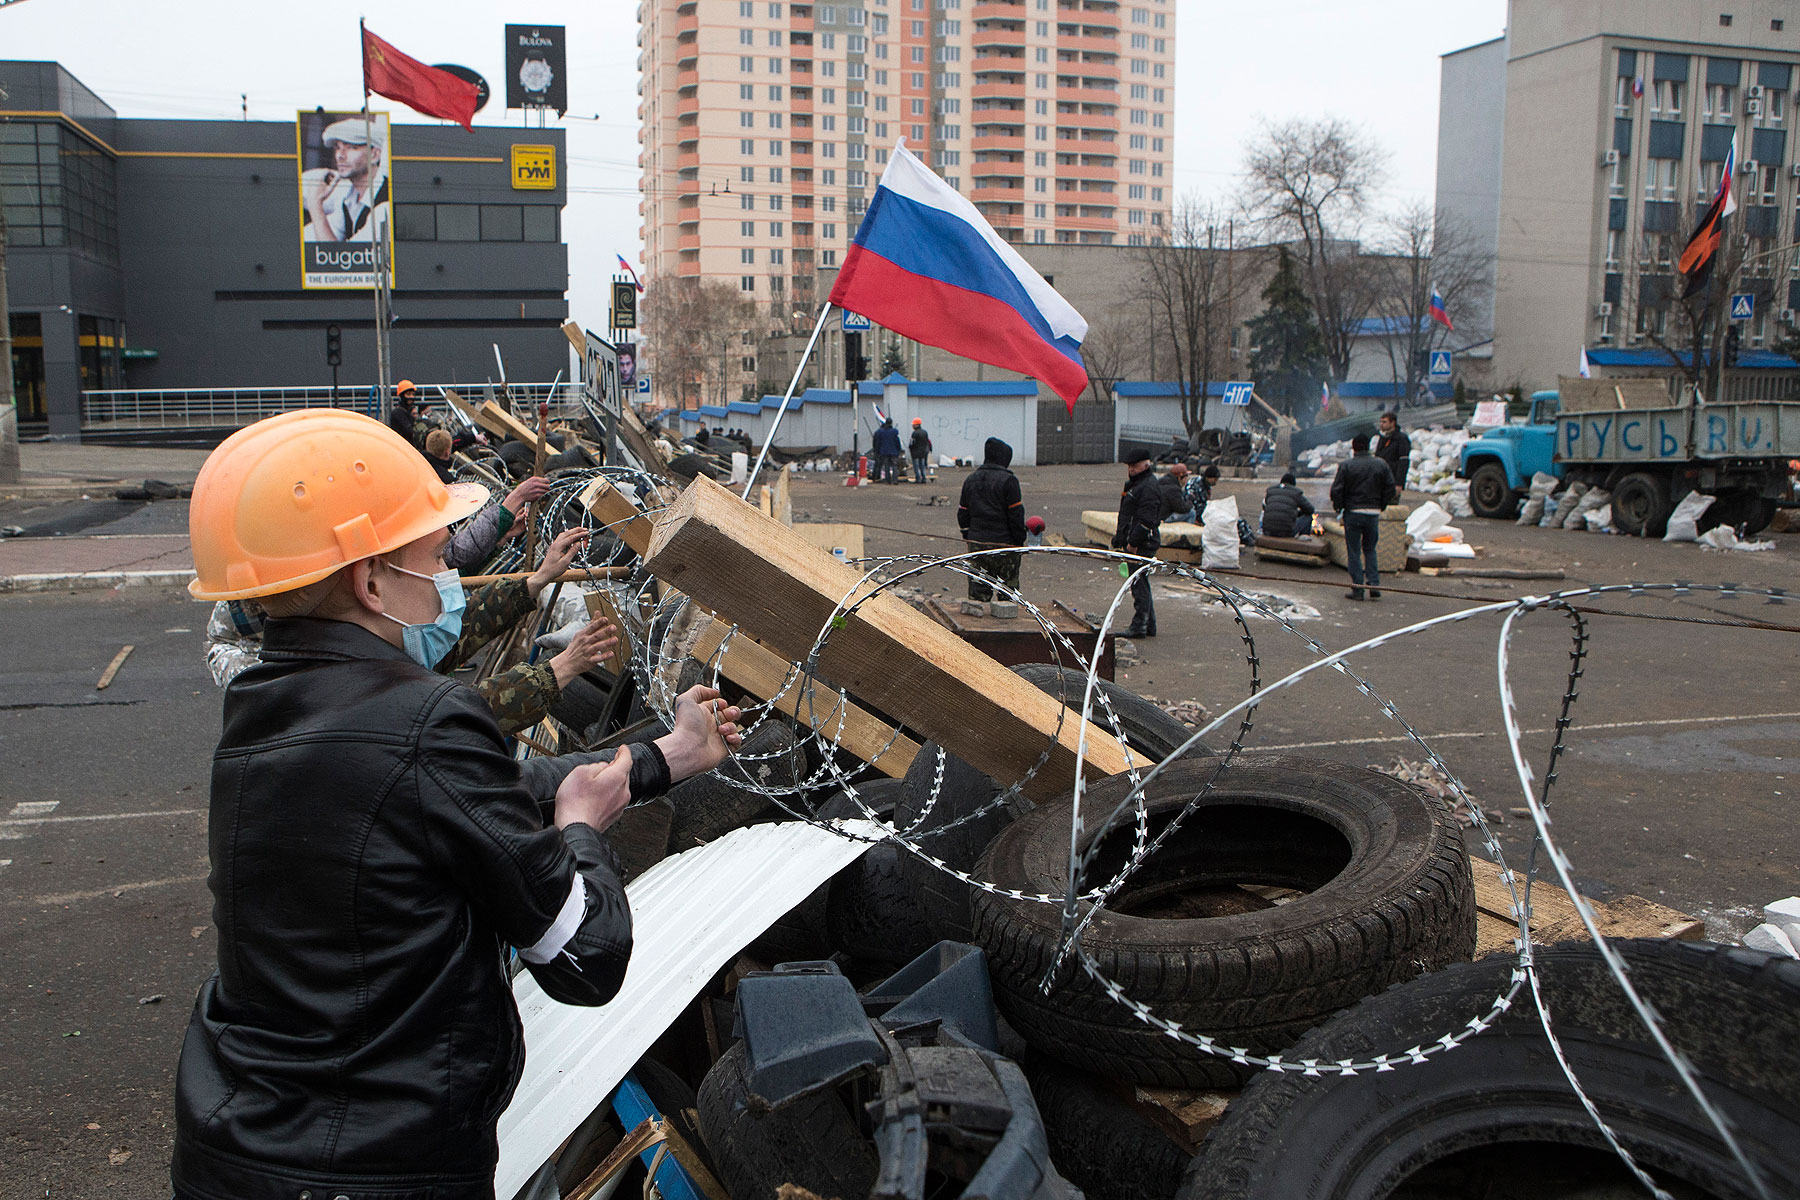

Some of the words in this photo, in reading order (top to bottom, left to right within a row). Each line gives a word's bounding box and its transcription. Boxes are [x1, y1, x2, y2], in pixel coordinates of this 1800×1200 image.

[518, 167, 550, 178] ГУМ
[308, 275, 322, 283] THE
[324, 275, 363, 284] EUROPEAN
[1566, 419, 1678, 458] РУСЬ
